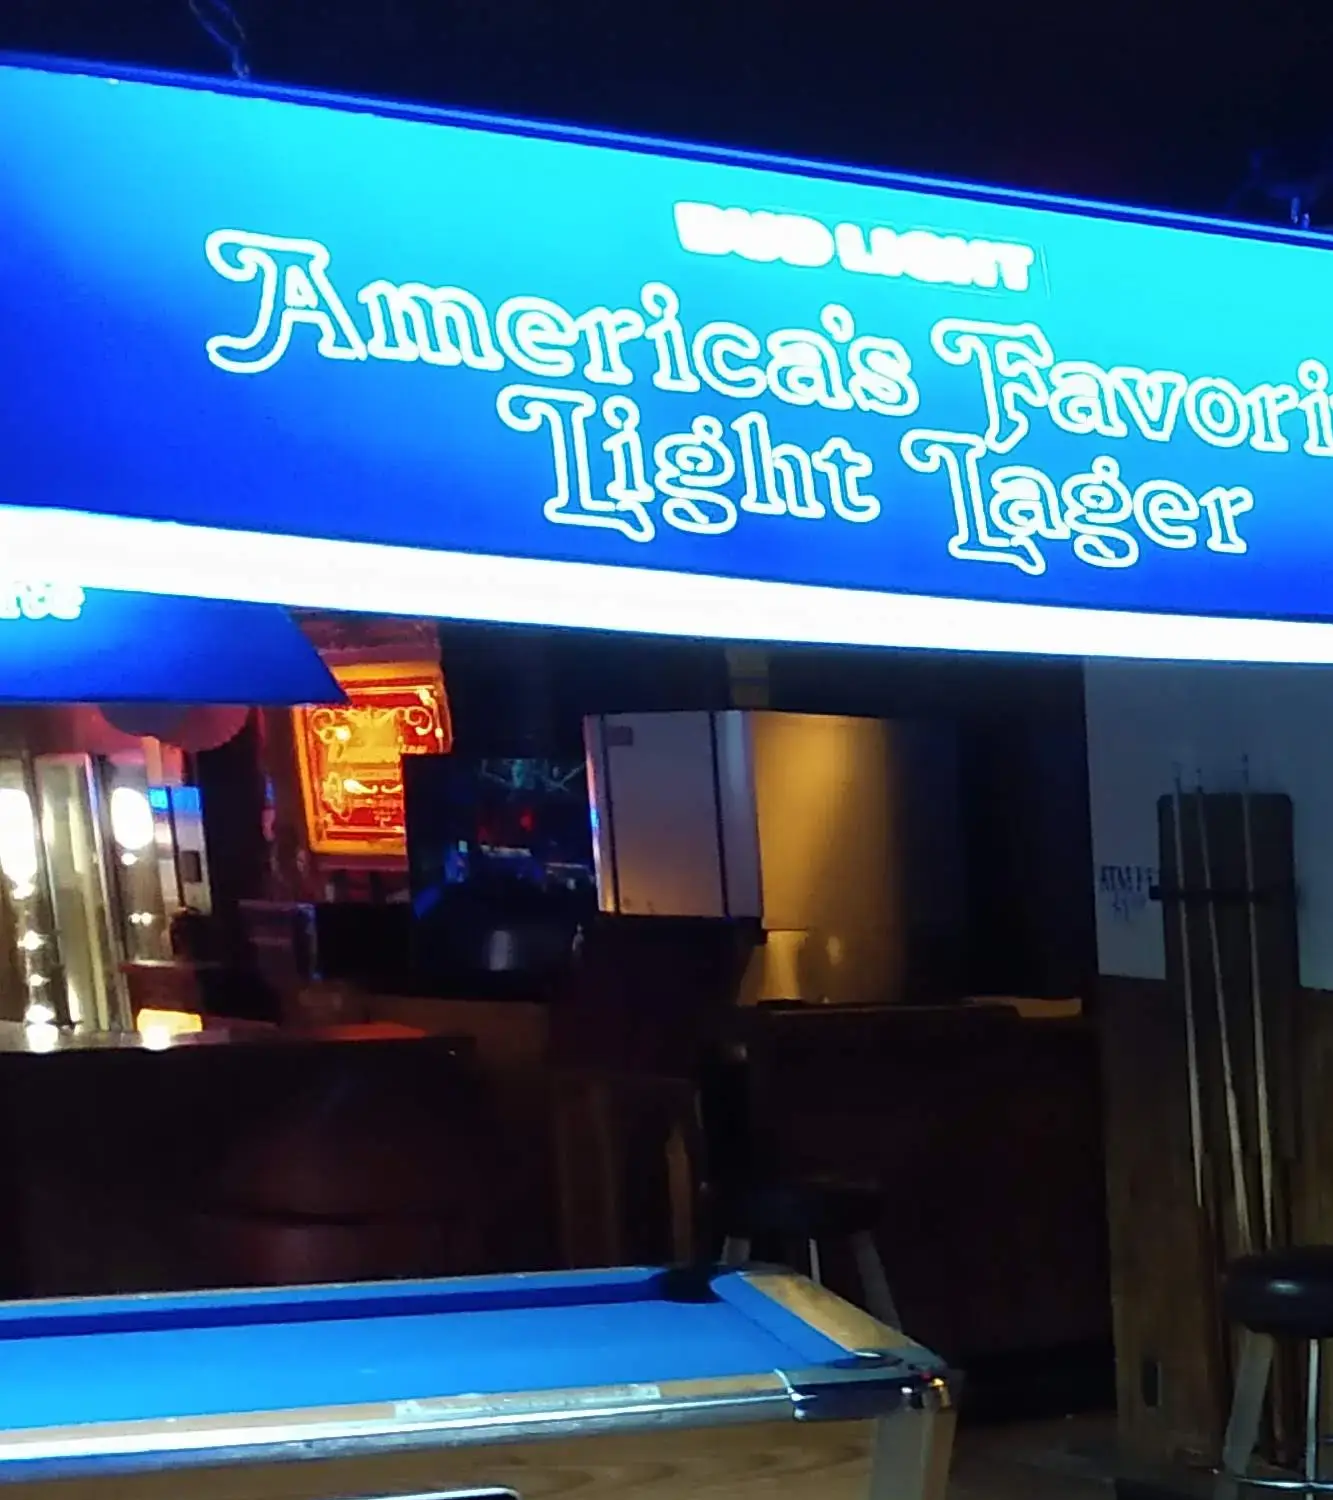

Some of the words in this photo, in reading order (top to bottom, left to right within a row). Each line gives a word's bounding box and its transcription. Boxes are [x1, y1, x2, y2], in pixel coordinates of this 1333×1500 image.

[205, 228, 919, 416] America's
[496, 384, 881, 543] Light
[900, 428, 1255, 576] Lager
